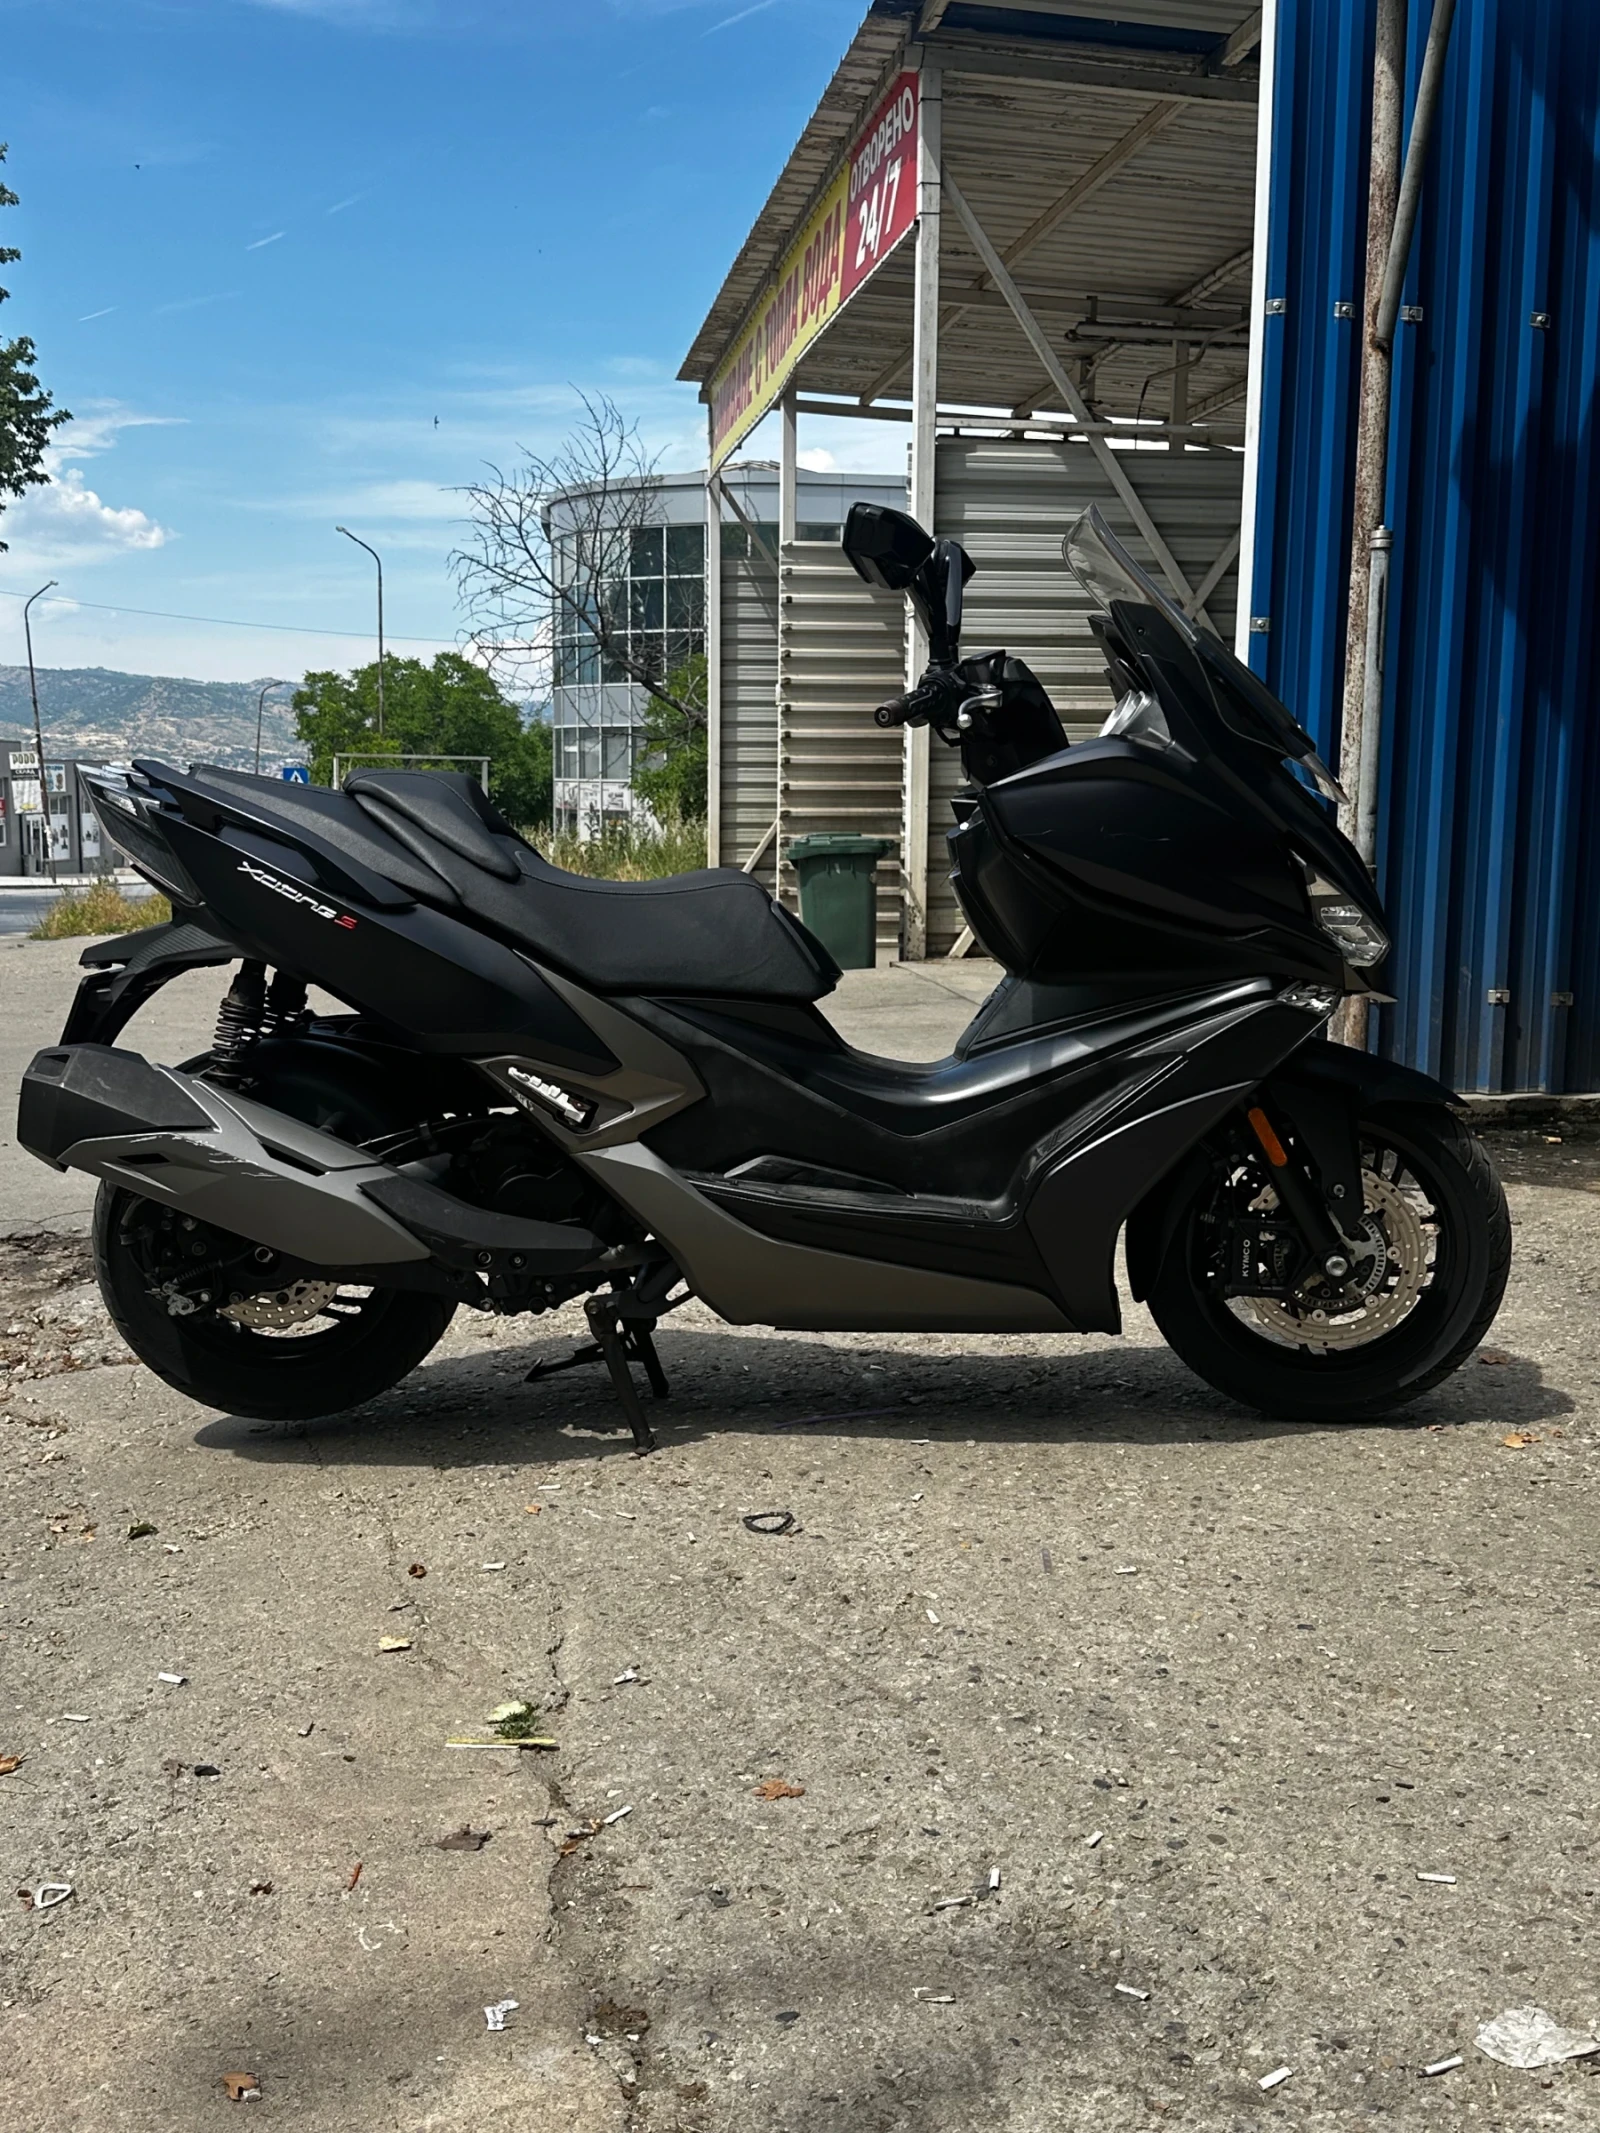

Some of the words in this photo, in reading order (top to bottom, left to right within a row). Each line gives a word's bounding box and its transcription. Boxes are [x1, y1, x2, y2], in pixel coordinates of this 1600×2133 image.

[850, 86, 914, 202] ОТВОРЕНО
[855, 156, 902, 270] 24/7
[755, 324, 762, 395] С
[765, 263, 799, 382] ТОПЛА
[801, 199, 841, 329] ВОДА
[1242, 1239, 1251, 1277] KYMCO
